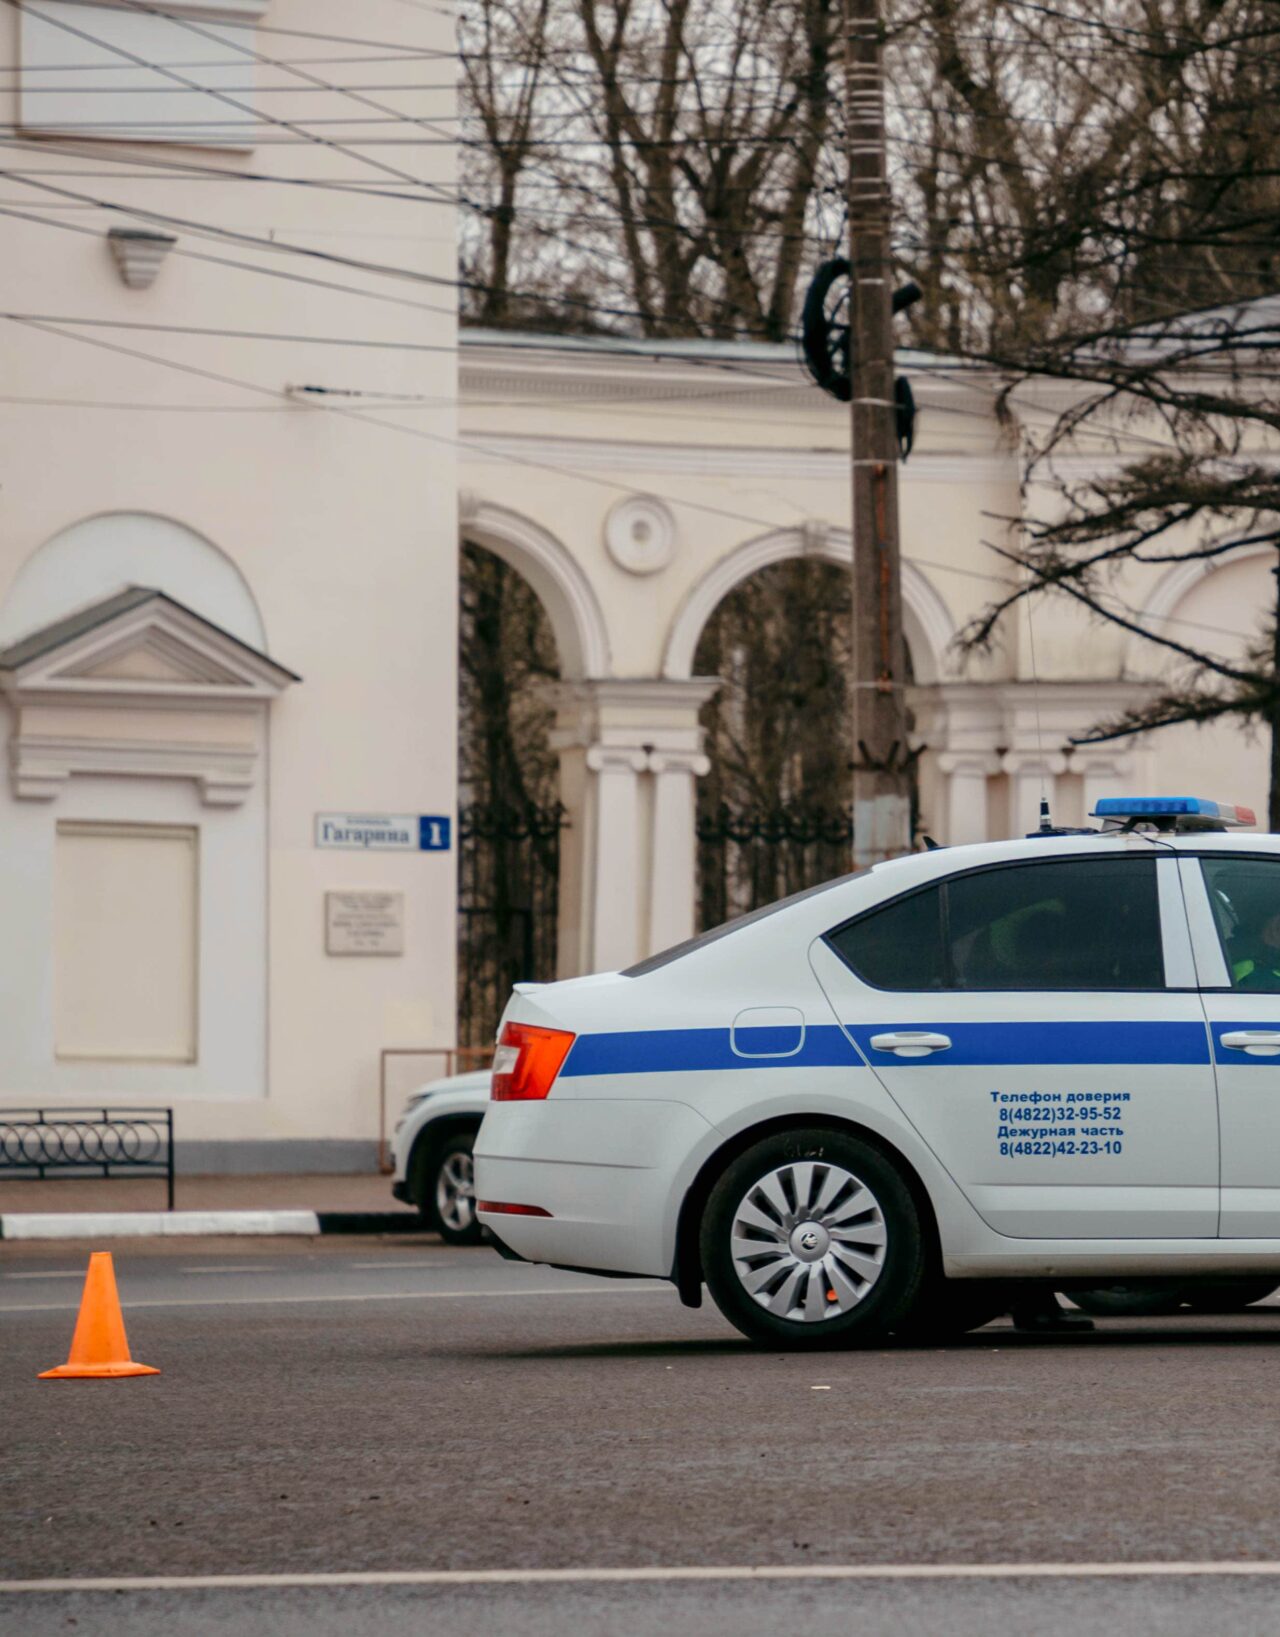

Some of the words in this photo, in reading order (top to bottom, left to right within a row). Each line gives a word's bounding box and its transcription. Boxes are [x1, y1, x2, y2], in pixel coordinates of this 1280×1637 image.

[322, 822, 410, 848] Гагарина
[429, 822, 442, 846] 1
[990, 1091, 1062, 1104] Телефон
[1066, 1092, 1131, 1104] доверия
[999, 1107, 1121, 1124] 8(4822)32-95-52
[997, 1126, 1076, 1139] Дежурная
[1081, 1126, 1124, 1136] часть
[1000, 1141, 1122, 1158] 8(4822)42-23-10
